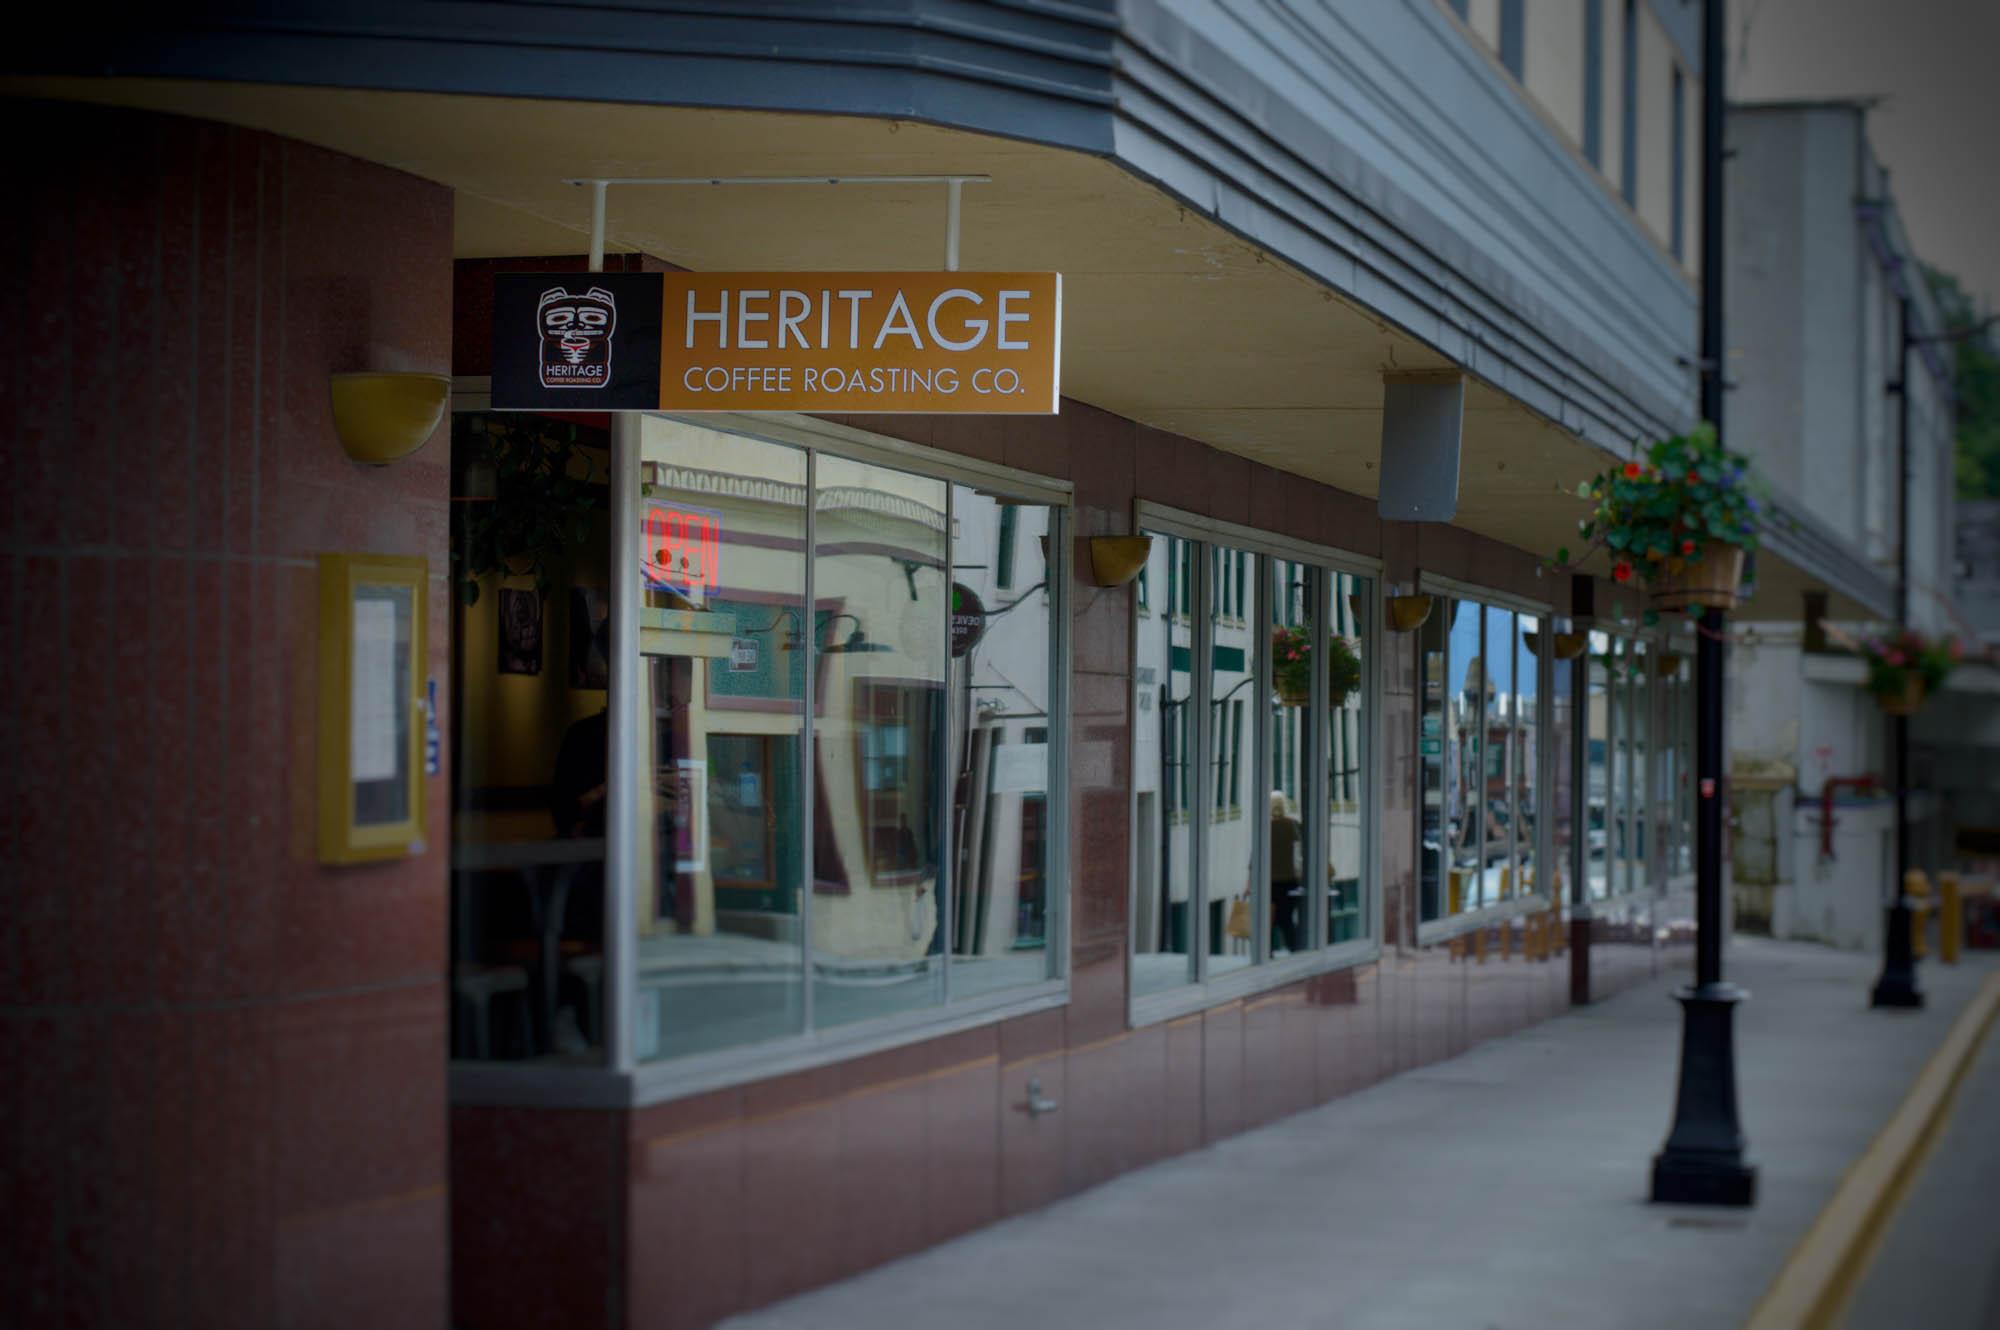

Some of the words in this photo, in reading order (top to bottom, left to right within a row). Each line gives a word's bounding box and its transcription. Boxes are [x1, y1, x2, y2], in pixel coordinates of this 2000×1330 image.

[685, 287, 1031, 351] HERITAGE
[546, 364, 603, 376] HERITAGE
[684, 366, 792, 392] COFFEE
[804, 367, 960, 394] ROASTING
[972, 367, 1025, 394] CO.
[647, 507, 719, 591] OPEN
